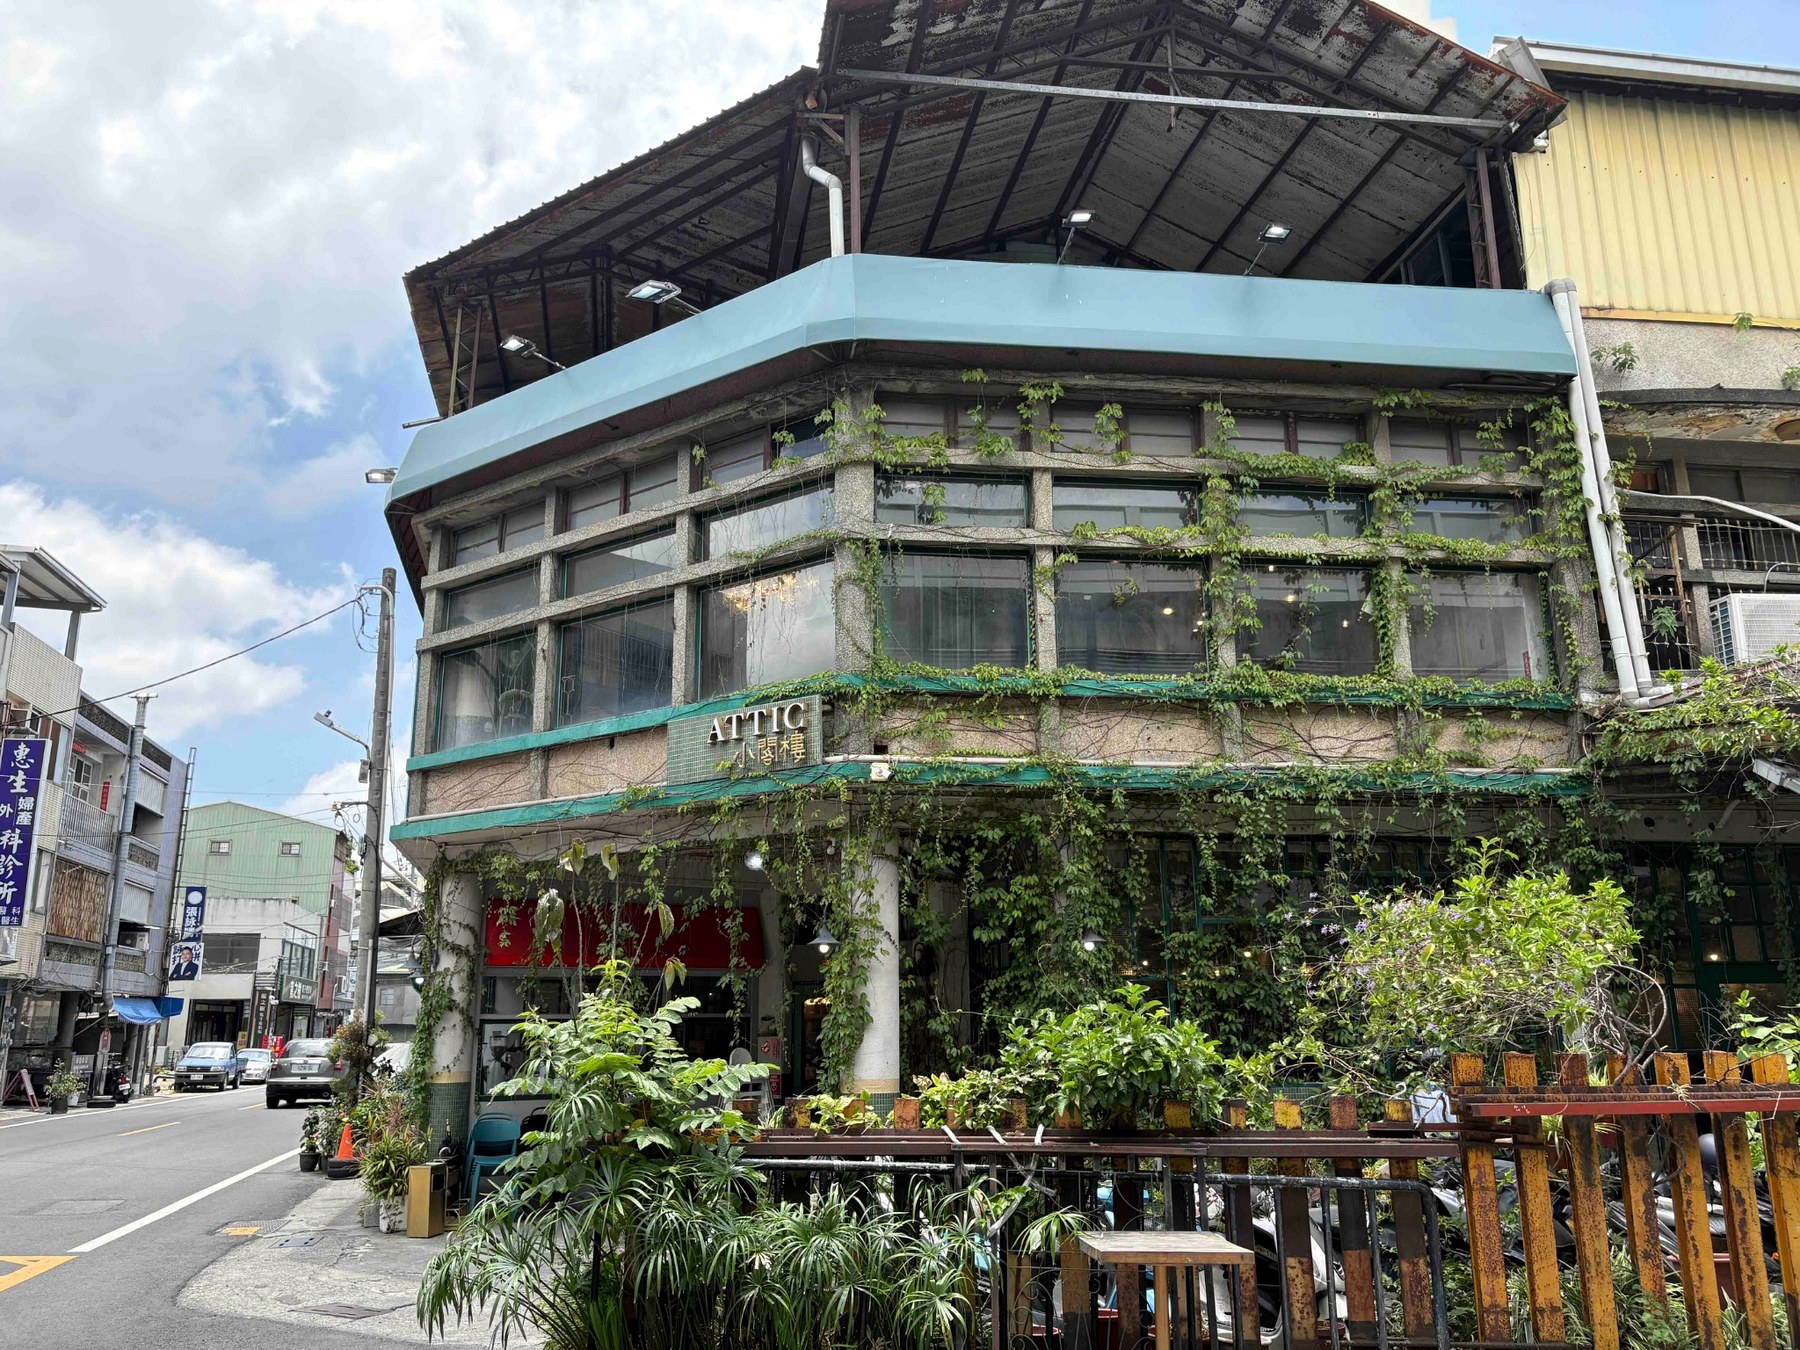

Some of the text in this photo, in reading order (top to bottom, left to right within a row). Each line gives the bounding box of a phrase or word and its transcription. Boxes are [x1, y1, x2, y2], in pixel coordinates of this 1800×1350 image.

[707, 702, 808, 744] ATTIC
[733, 730, 806, 769] 小閣樓
[15, 796, 35, 826] 婦產
